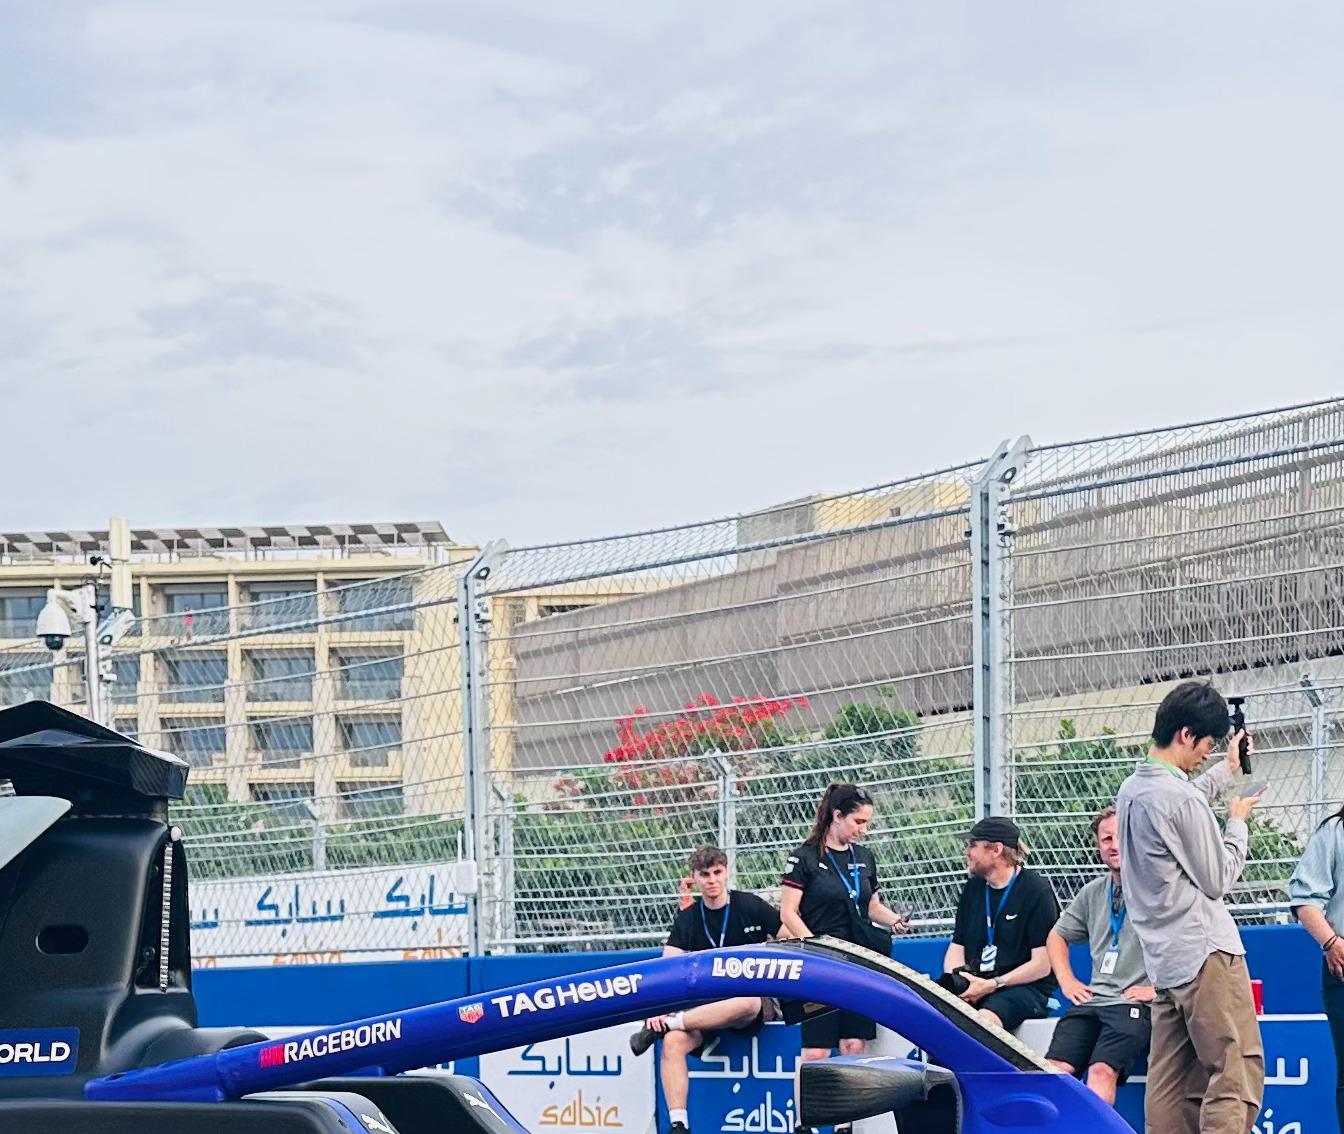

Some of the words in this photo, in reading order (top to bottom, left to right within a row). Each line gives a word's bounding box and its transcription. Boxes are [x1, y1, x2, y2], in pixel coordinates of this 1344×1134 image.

[711, 956, 804, 981] LOCTITE
[283, 1018, 402, 1065] RACEBORN
[538, 1088, 625, 1128] sabic
[720, 1091, 796, 1134] sabi
